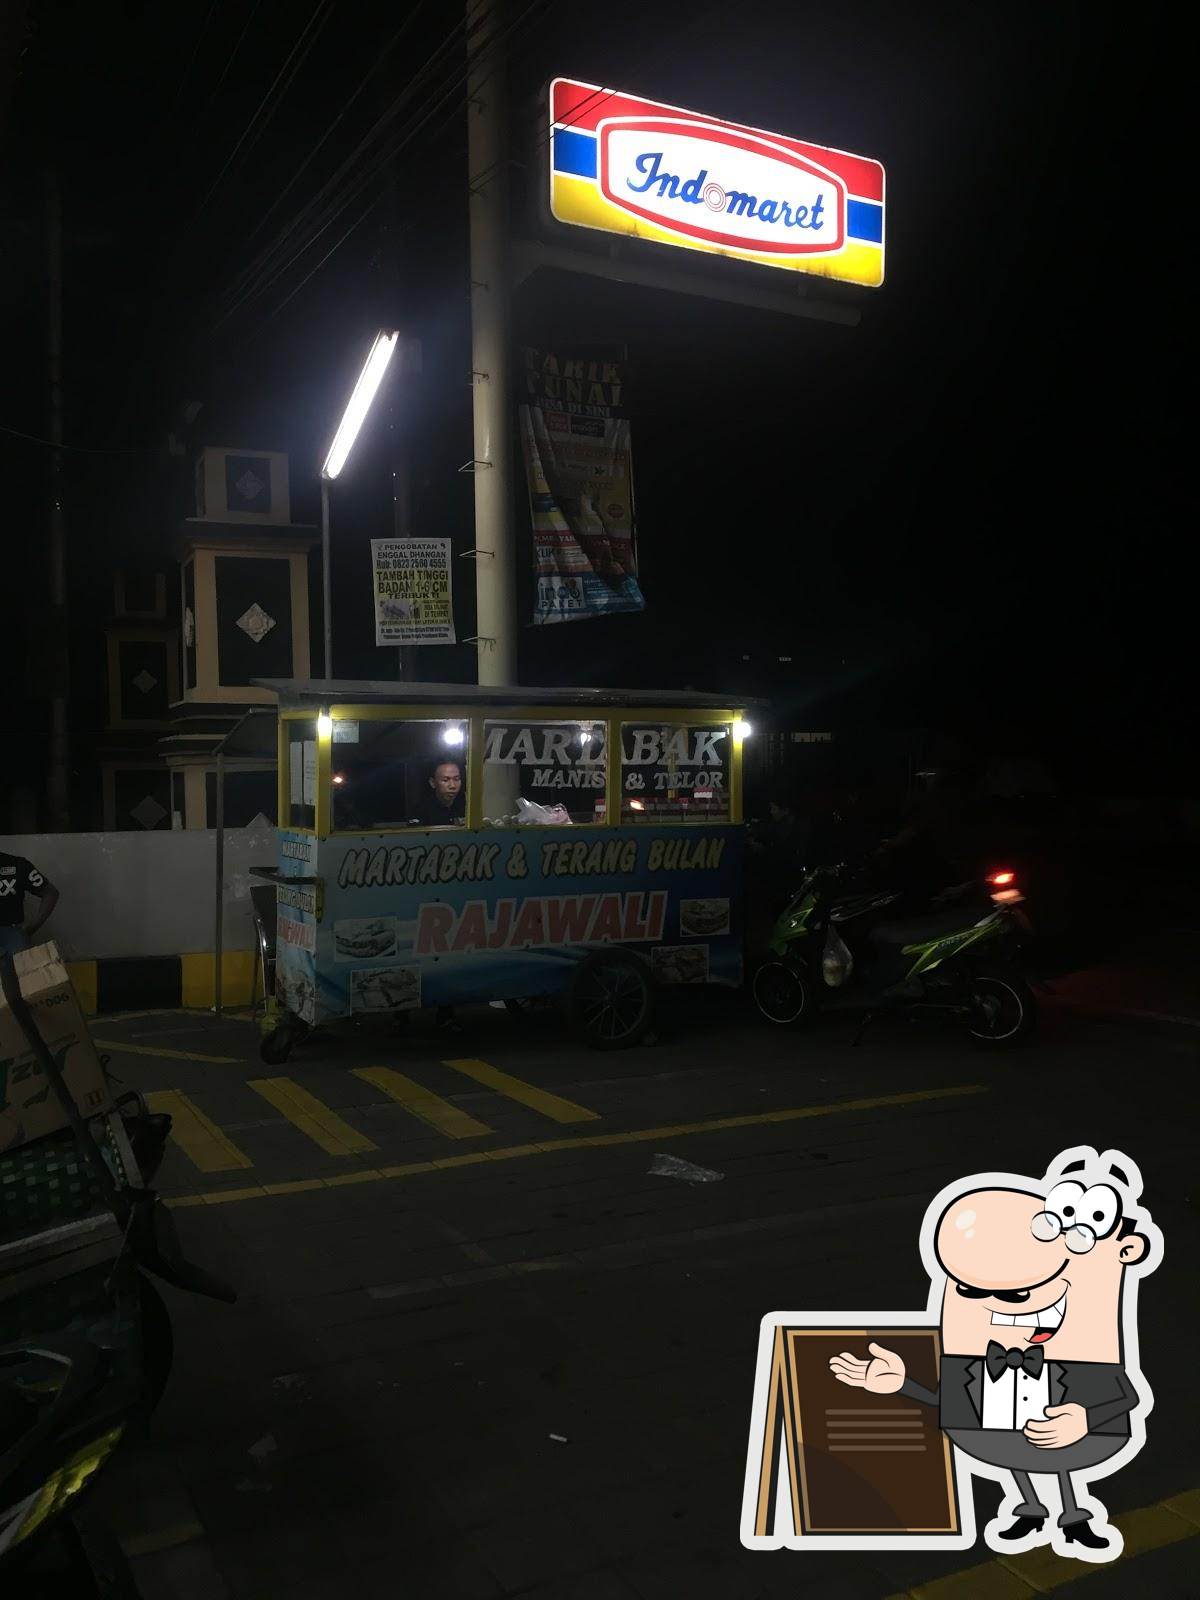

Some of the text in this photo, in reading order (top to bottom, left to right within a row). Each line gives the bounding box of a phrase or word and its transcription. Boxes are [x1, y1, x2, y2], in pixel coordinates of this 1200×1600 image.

[625, 152, 825, 231] Indomaret
[377, 551, 447, 559] ENGGAL DHANGAN
[376, 570, 449, 581] TAMBAH TINGGI
[378, 581, 412, 593] BADAN
[432, 581, 448, 593] CM
[531, 768, 724, 791] MANIS & TELOR
[338, 836, 727, 889] MARTABAK & TERANG BULAN
[413, 889, 669, 959] RAJAWALI
